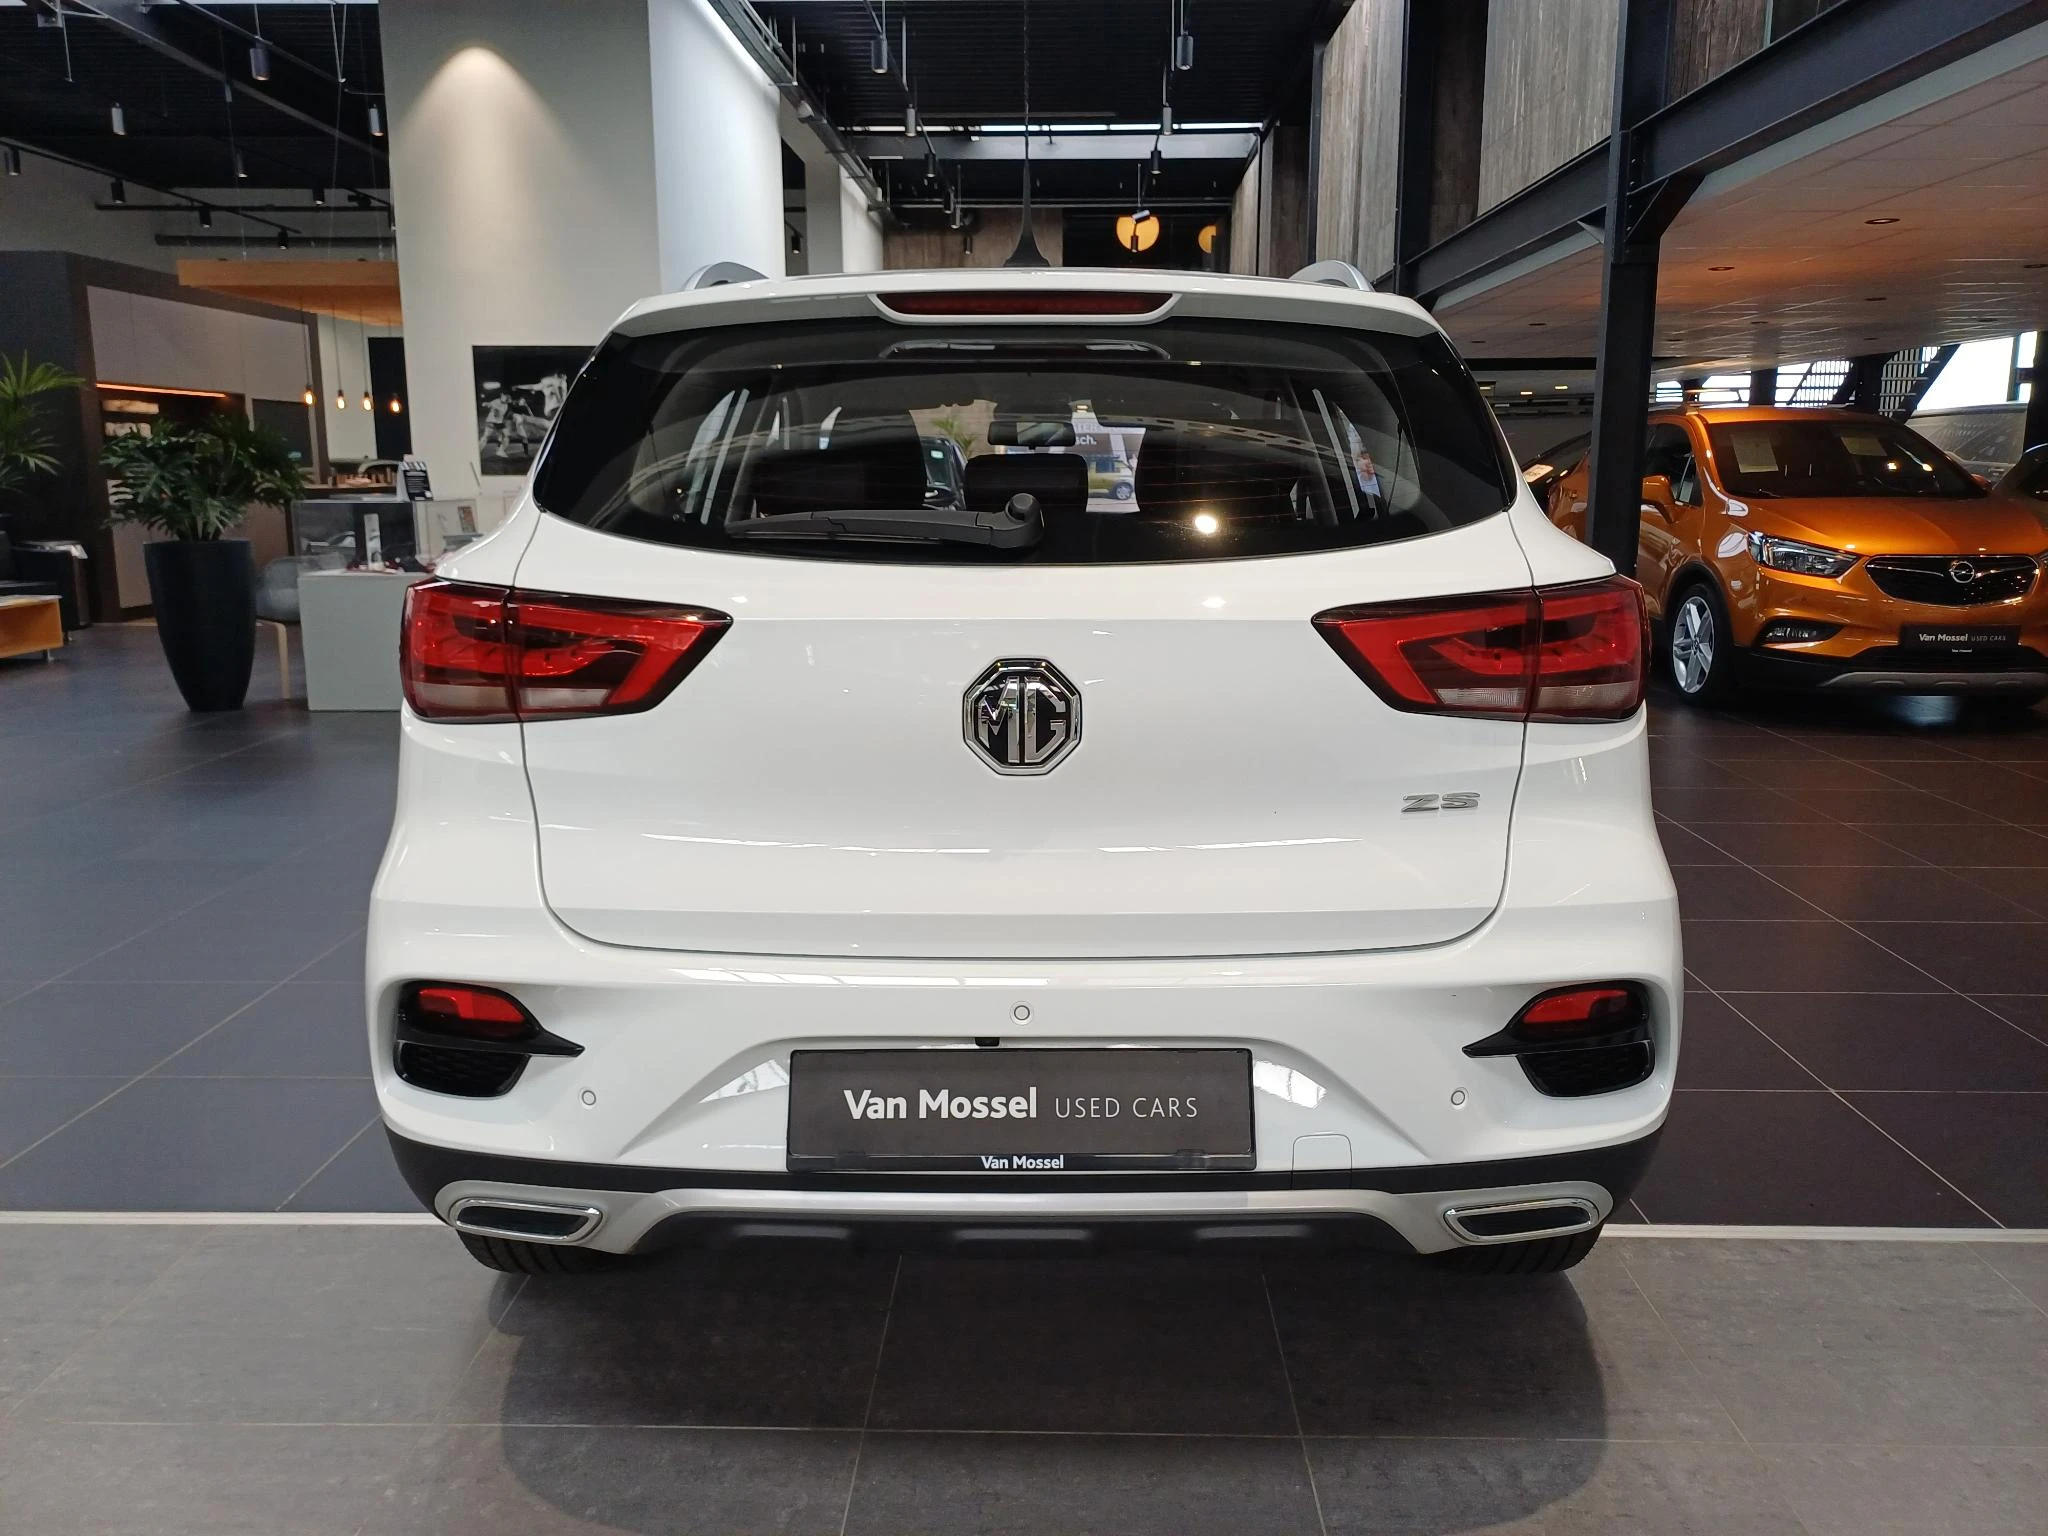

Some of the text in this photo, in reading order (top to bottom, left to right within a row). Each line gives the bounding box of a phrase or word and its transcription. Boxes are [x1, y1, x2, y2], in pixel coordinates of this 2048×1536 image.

[1919, 633, 1935, 641] Van
[1938, 633, 1968, 641] Mossel
[978, 676, 1066, 763] MG
[1401, 792, 1480, 812] ZS
[844, 1086, 1198, 1120] Van Mossel USED CARS
[980, 1154, 1064, 1169] Van Mossel
